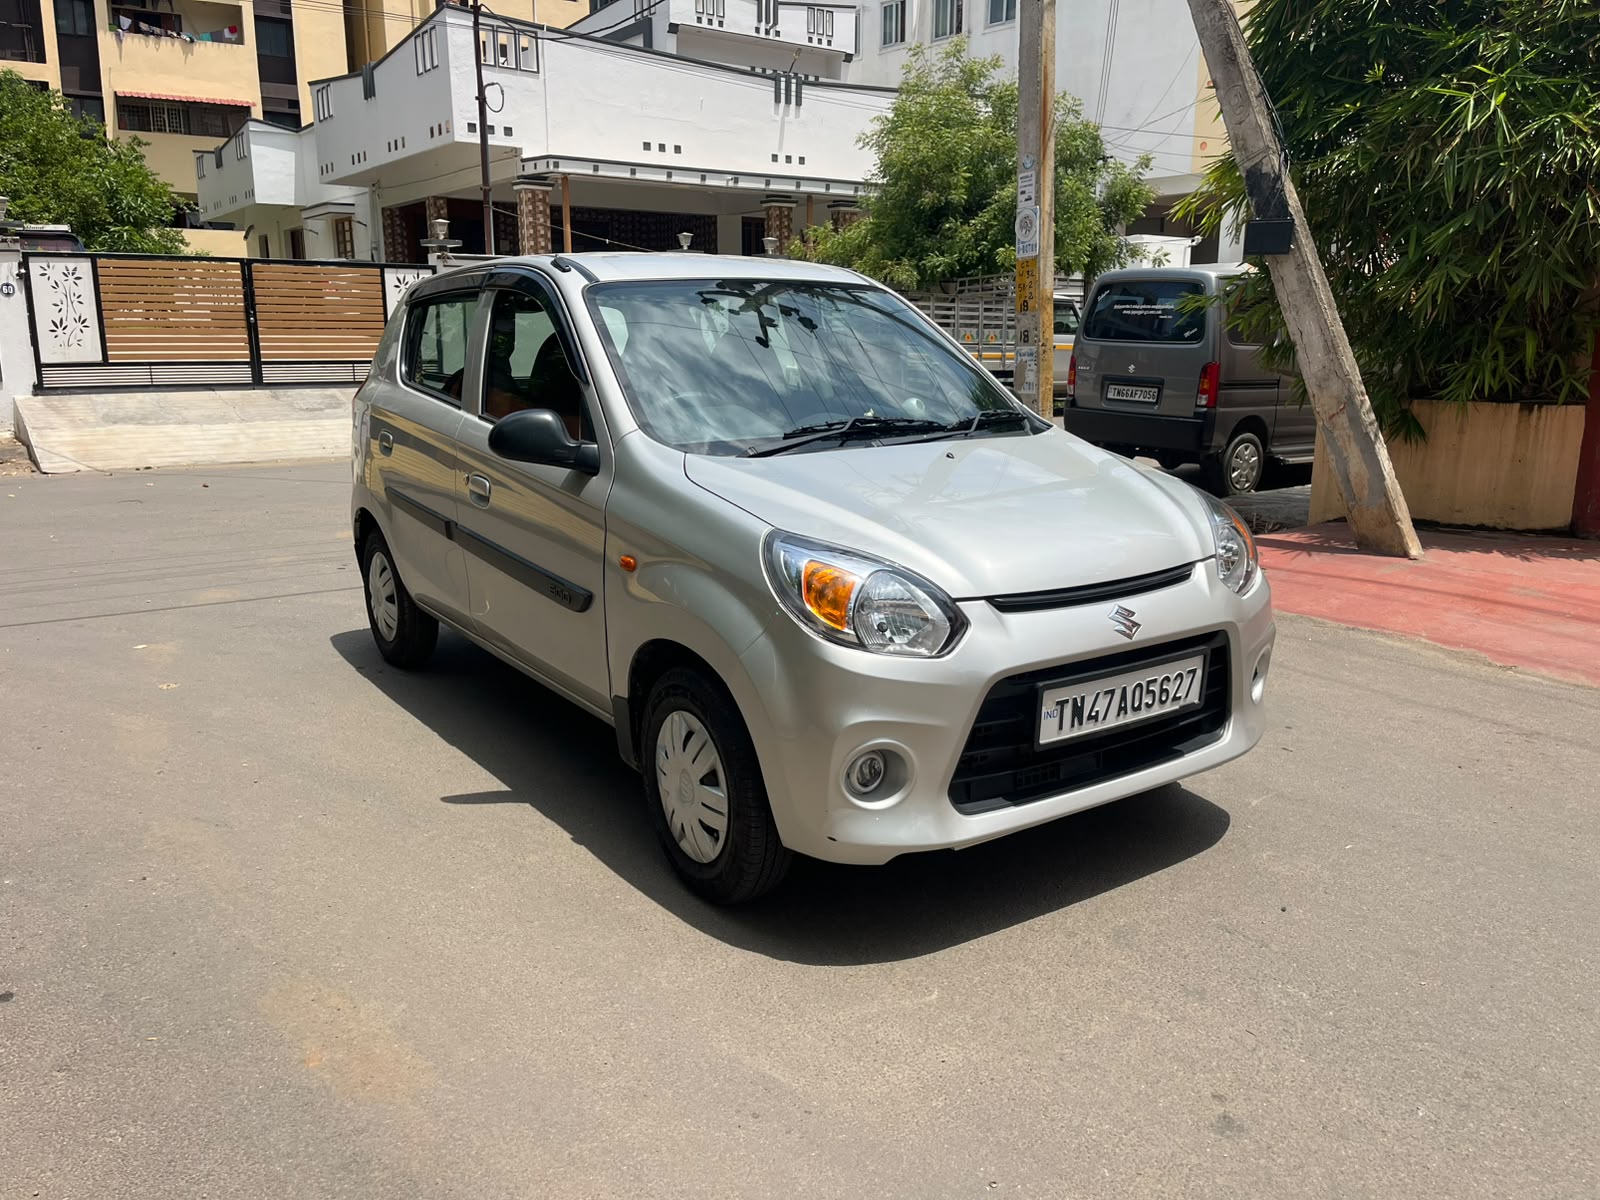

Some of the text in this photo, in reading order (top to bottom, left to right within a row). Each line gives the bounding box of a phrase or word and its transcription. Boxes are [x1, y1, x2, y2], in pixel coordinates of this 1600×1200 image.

[2, 285, 13, 294] 60
[1019, 300, 1029, 313] 18
[1019, 329, 1029, 343] 18
[1112, 387, 1157, 401] TN66AF7056
[1043, 667, 1198, 731] IND TN47AQ5627
